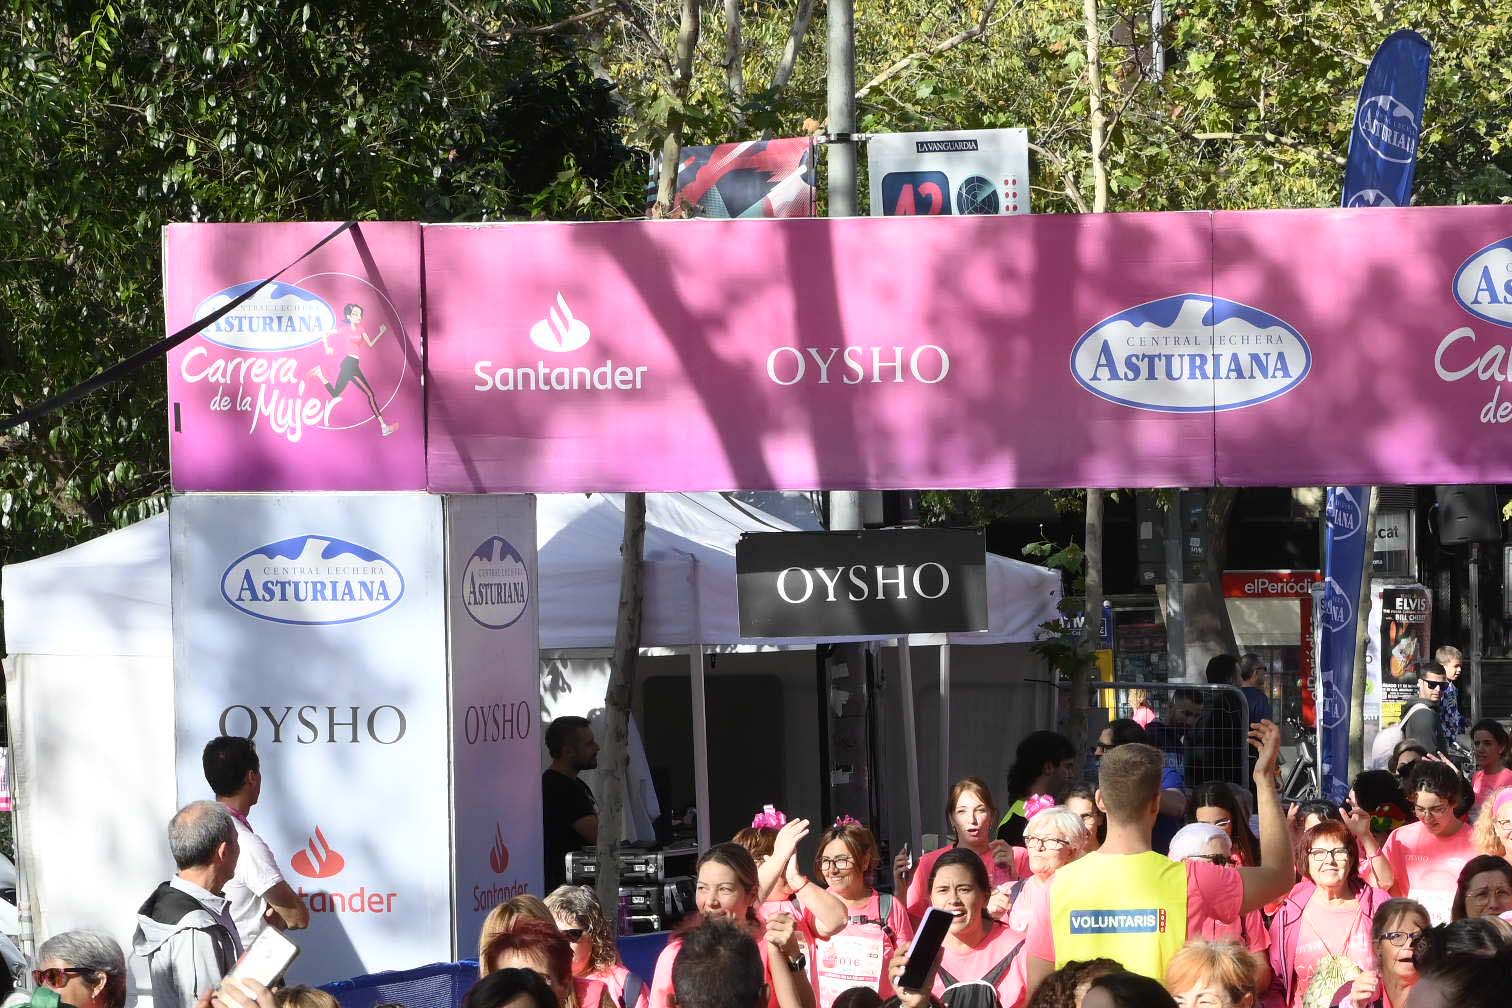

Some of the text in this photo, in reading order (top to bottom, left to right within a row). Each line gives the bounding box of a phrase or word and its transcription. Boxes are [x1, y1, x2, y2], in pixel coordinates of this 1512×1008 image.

[1126, 334, 1285, 347] CENTRAL LECHERA
[180, 347, 299, 384] Carrera
[474, 360, 648, 392] Santander
[766, 345, 950, 385] OYSHO
[1089, 338, 1293, 382] ASTURIANA
[209, 380, 344, 443] de la Mujer
[236, 568, 391, 602] ASTURIANA
[263, 566, 385, 576] CENTRAL LECHERA
[776, 561, 950, 604] OYSHO
[467, 572, 525, 605] ASTURIANA
[1395, 597, 1426, 610] ELVIS
[218, 704, 407, 745] OYSHO
[464, 699, 531, 745] OYSHO
[297, 886, 398, 913] tander
[1071, 915, 1156, 929] VOLUNTARIS
